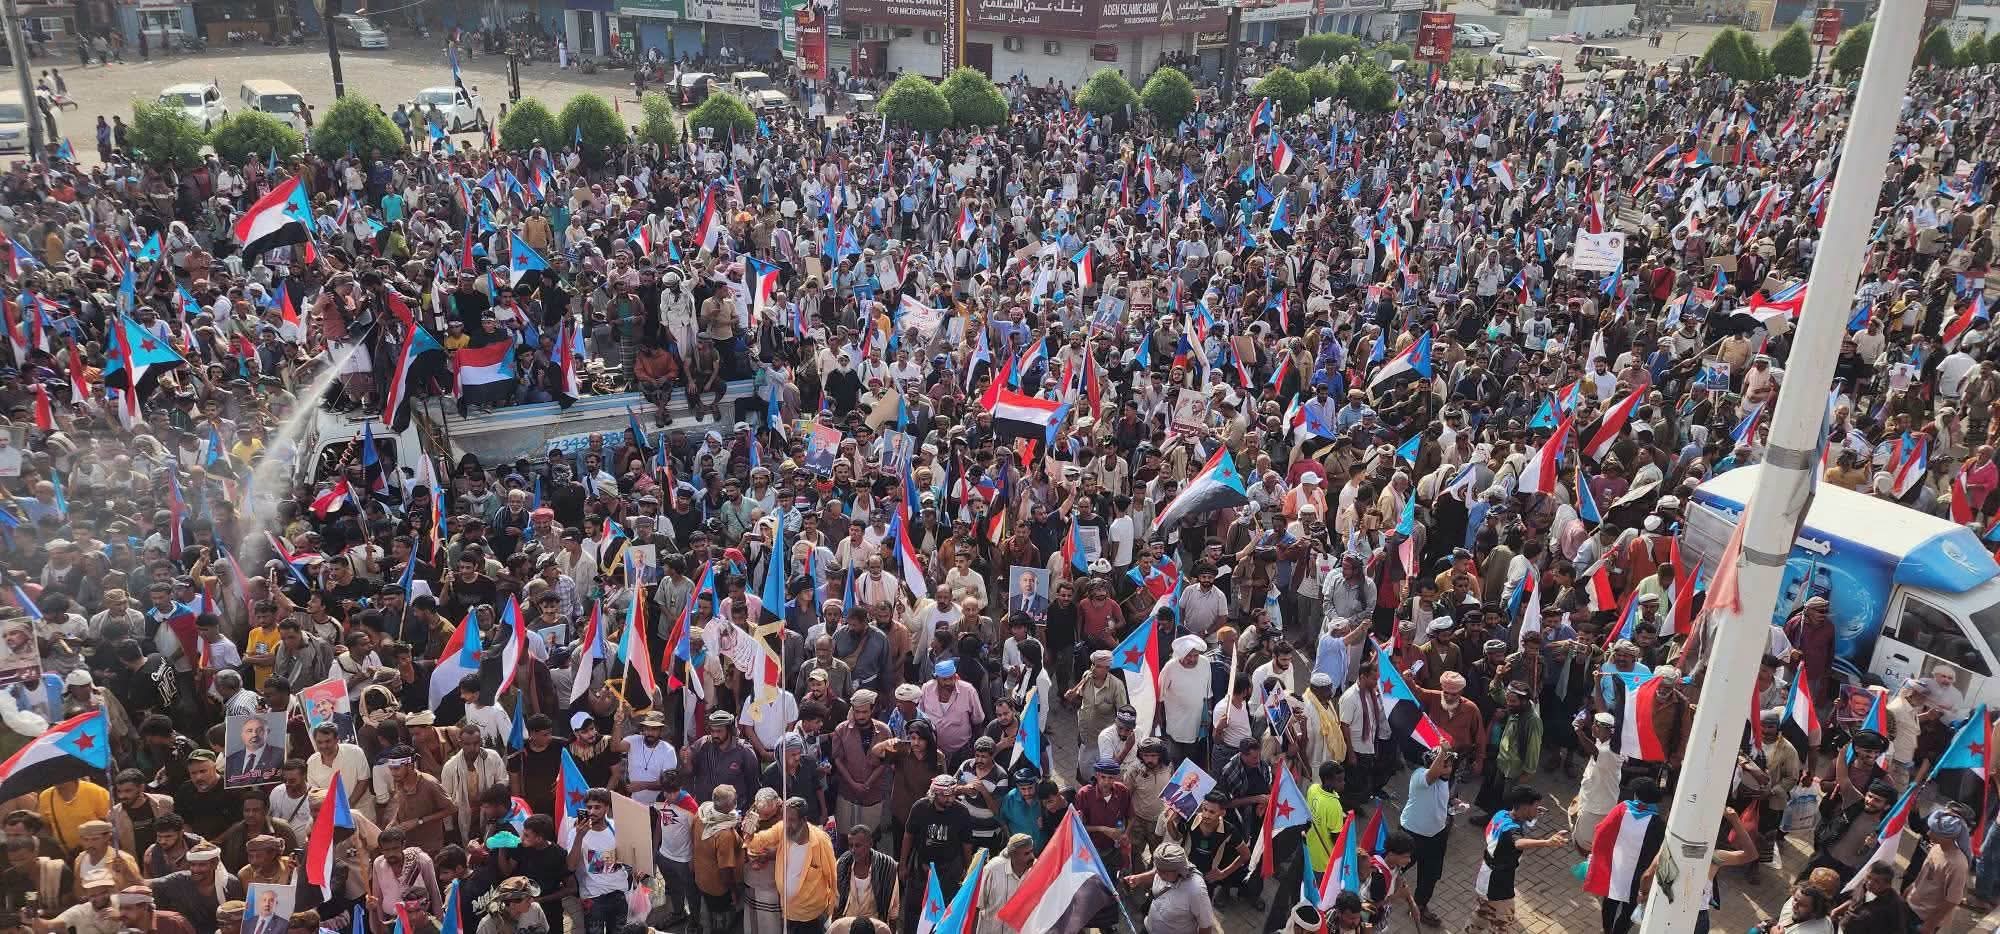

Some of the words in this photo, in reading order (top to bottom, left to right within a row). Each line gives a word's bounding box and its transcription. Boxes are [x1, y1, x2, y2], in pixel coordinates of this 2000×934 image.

[887, 6, 899, 14] FOR
[900, 7, 942, 17] MICROFINANCE
[1103, 4, 1120, 17] ADEN
[1120, 3, 1142, 16] ISLAMIC
[1142, 2, 1159, 14] BANK
